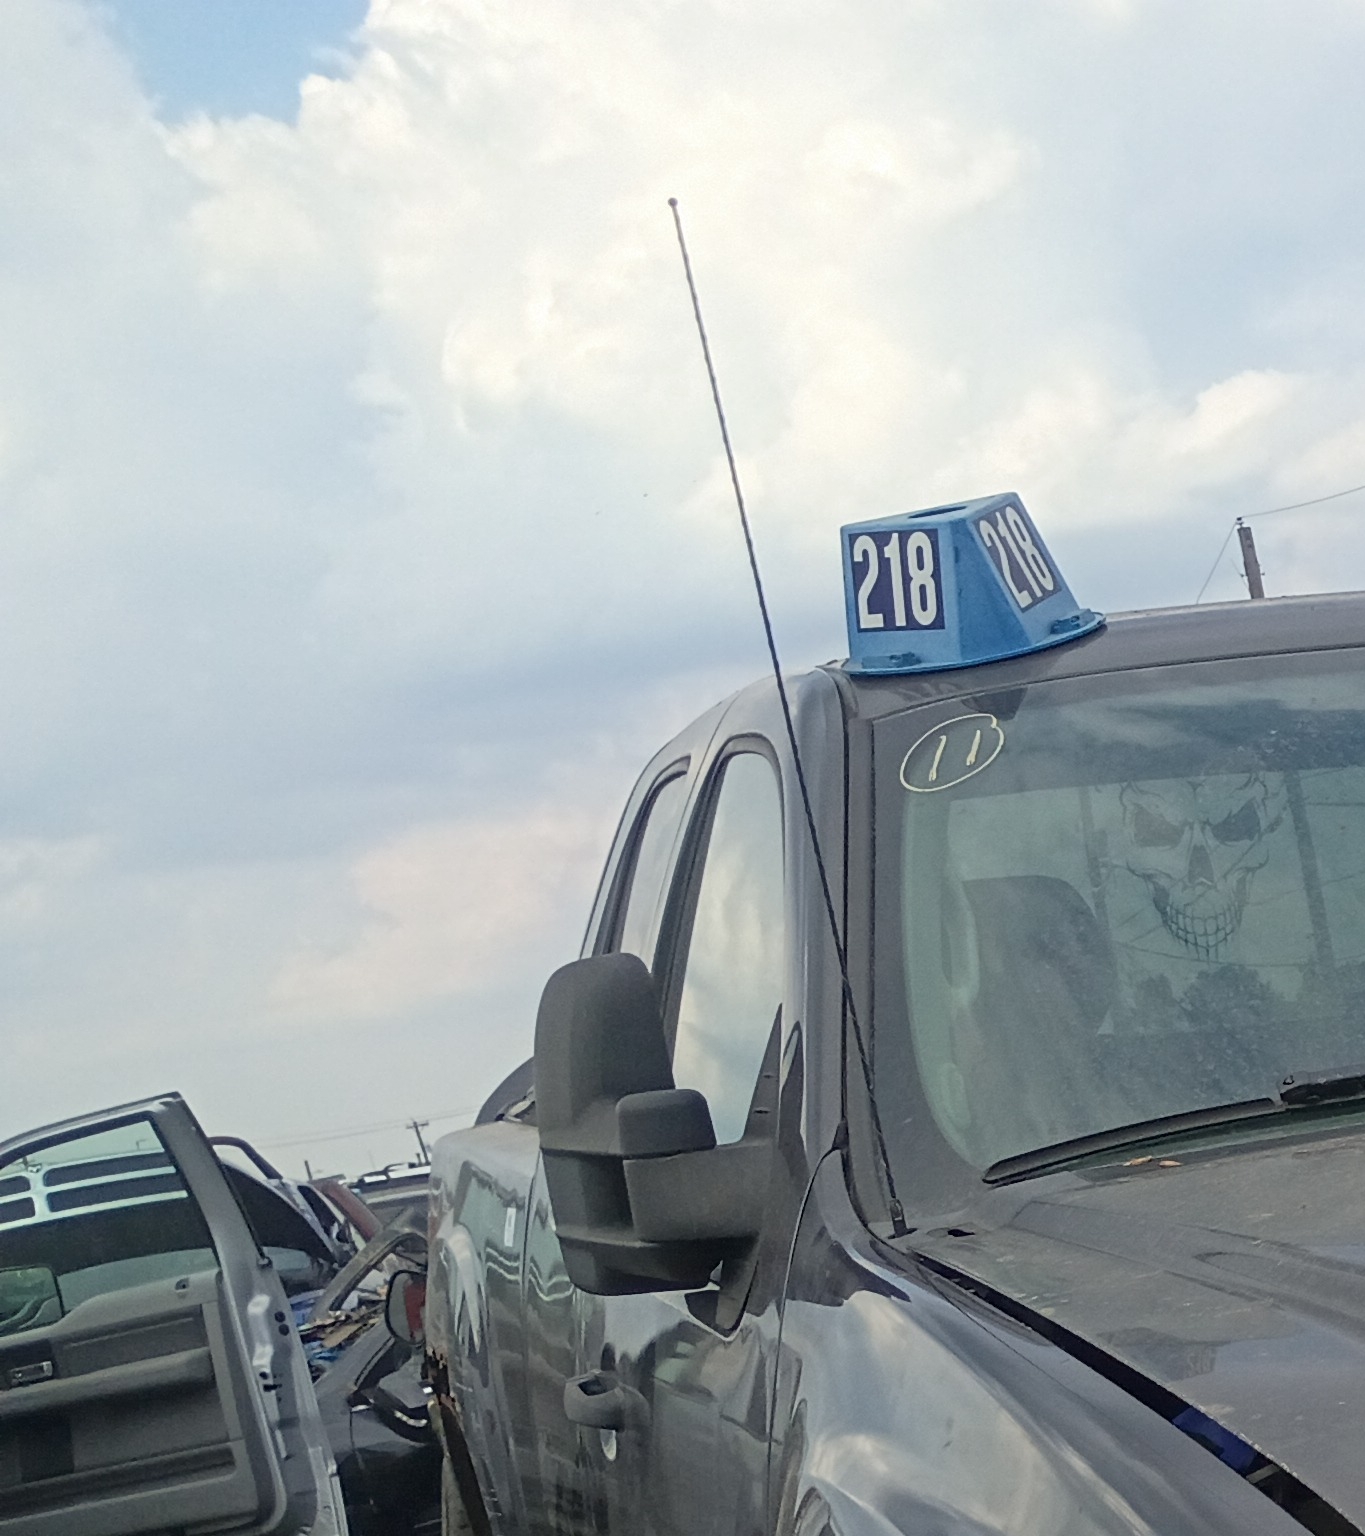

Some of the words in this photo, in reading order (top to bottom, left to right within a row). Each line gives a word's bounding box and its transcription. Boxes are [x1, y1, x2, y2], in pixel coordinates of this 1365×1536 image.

[853, 531, 938, 629] 218
[979, 505, 1054, 609] 218
[928, 729, 981, 782] 11
